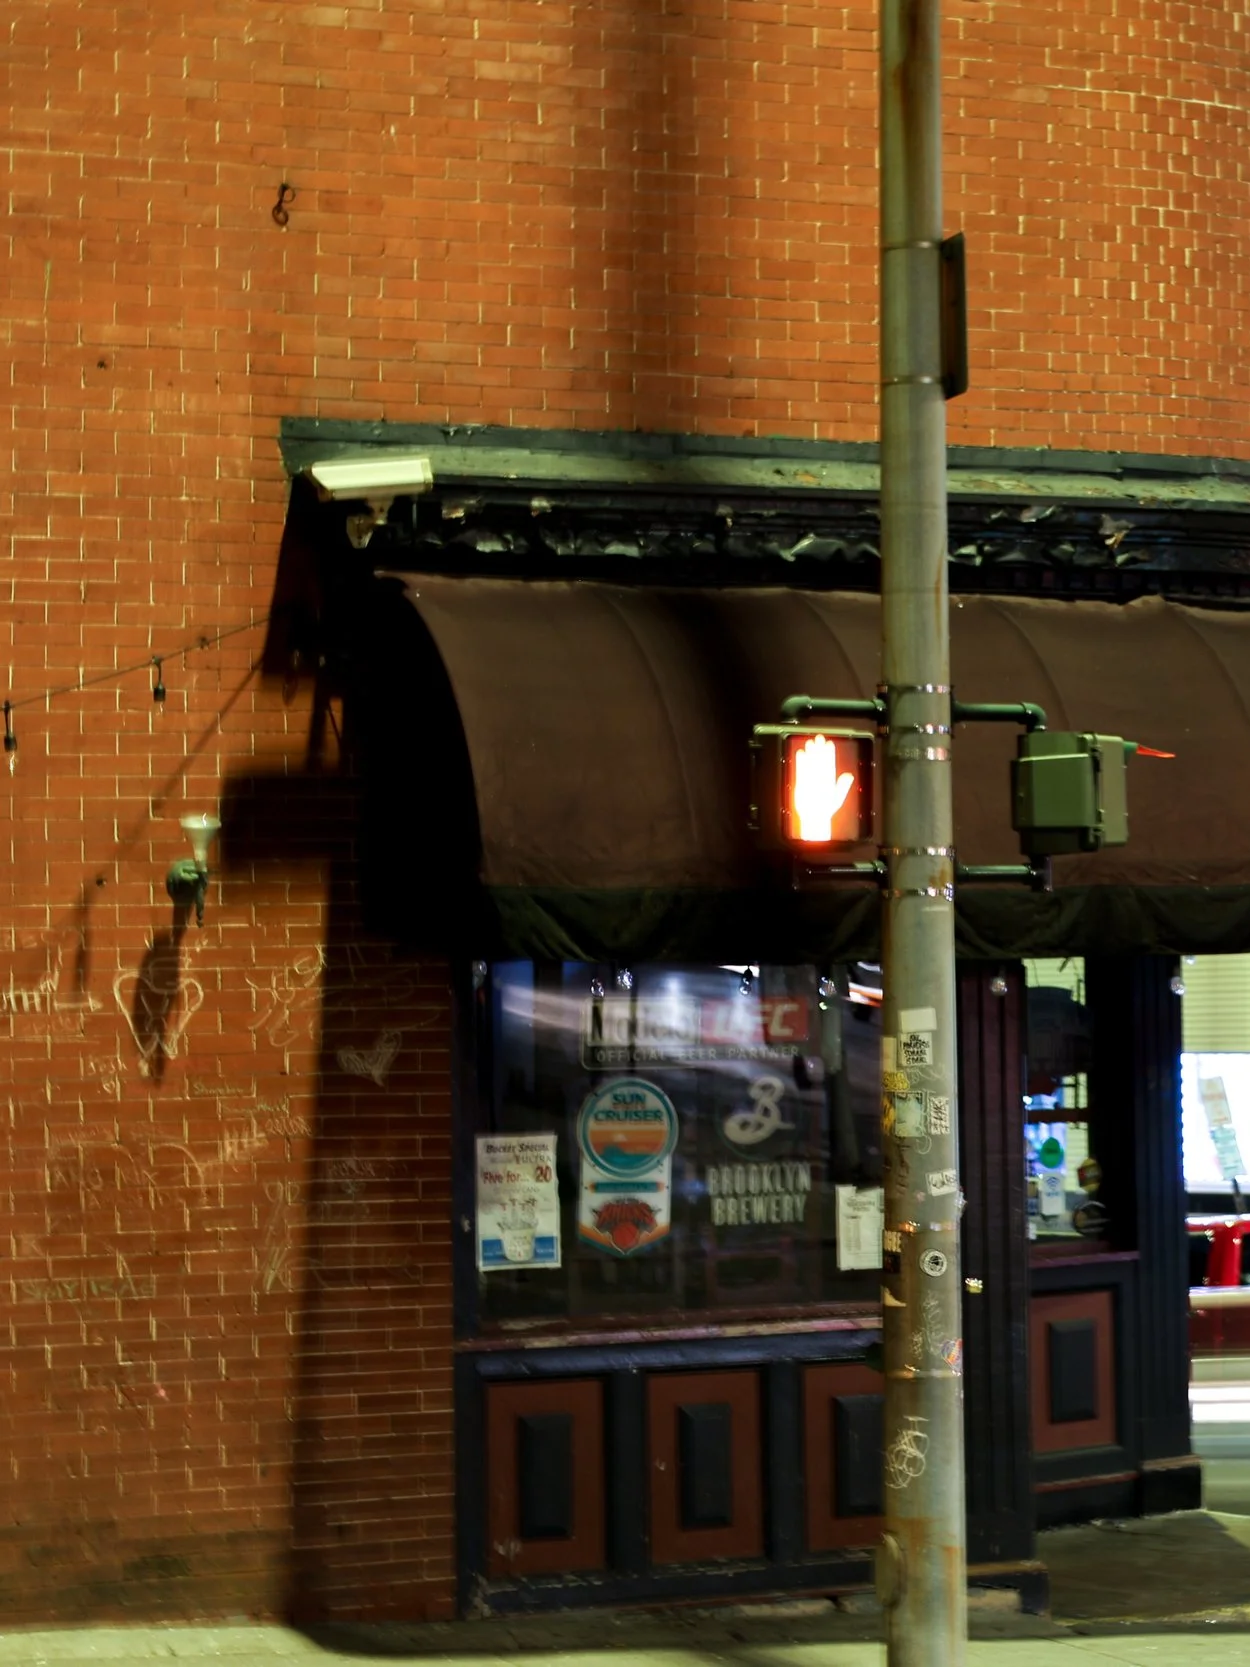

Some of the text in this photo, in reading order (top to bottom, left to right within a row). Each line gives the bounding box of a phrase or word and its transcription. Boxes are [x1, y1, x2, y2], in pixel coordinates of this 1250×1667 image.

[713, 1003, 801, 1038] UFC
[597, 1045, 801, 1063] OFFICIAL BEER PARTNER
[612, 1093, 647, 1106] SUN
[594, 1109, 664, 1122] CRUISER
[535, 1165, 553, 1183] 20
[707, 1162, 812, 1196] BROOKLYN
[712, 1193, 807, 1226] BREWERY
